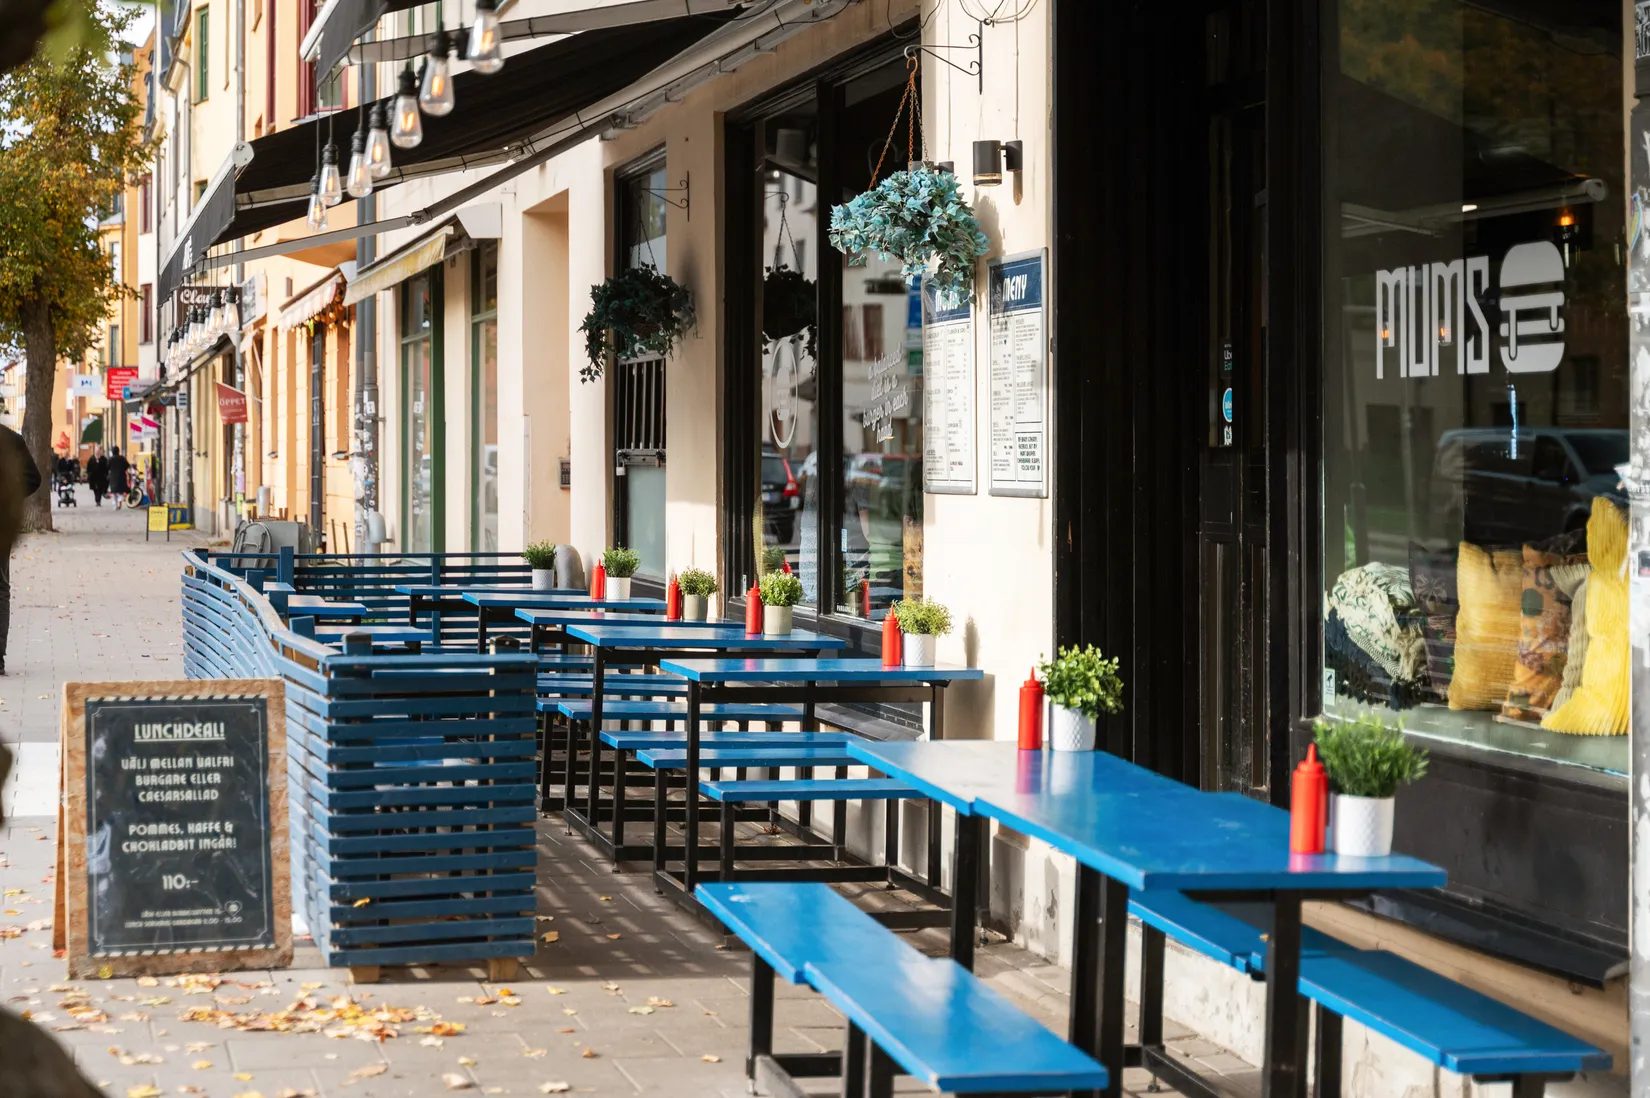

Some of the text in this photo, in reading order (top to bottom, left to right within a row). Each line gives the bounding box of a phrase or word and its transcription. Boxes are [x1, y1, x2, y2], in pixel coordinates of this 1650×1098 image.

[1003, 273, 1028, 302] MENY
[1376, 255, 1490, 380] MUMS
[874, 341, 902, 377] balanced
[871, 376, 884, 401] diet
[863, 385, 909, 432] burger in each
[877, 416, 893, 445] hand
[134, 722, 225, 740] LUNCHDEAL!
[150, 758, 193, 770] MELLAN
[135, 772, 222, 786] BURGARE ELLER
[138, 789, 219, 802] CAESARSALLAD
[187, 822, 221, 833] KAFFE
[224, 821, 233, 834] &
[122, 833, 237, 853] CHOKLADBIT INGÅR!
[162, 873, 199, 890] 110:-
